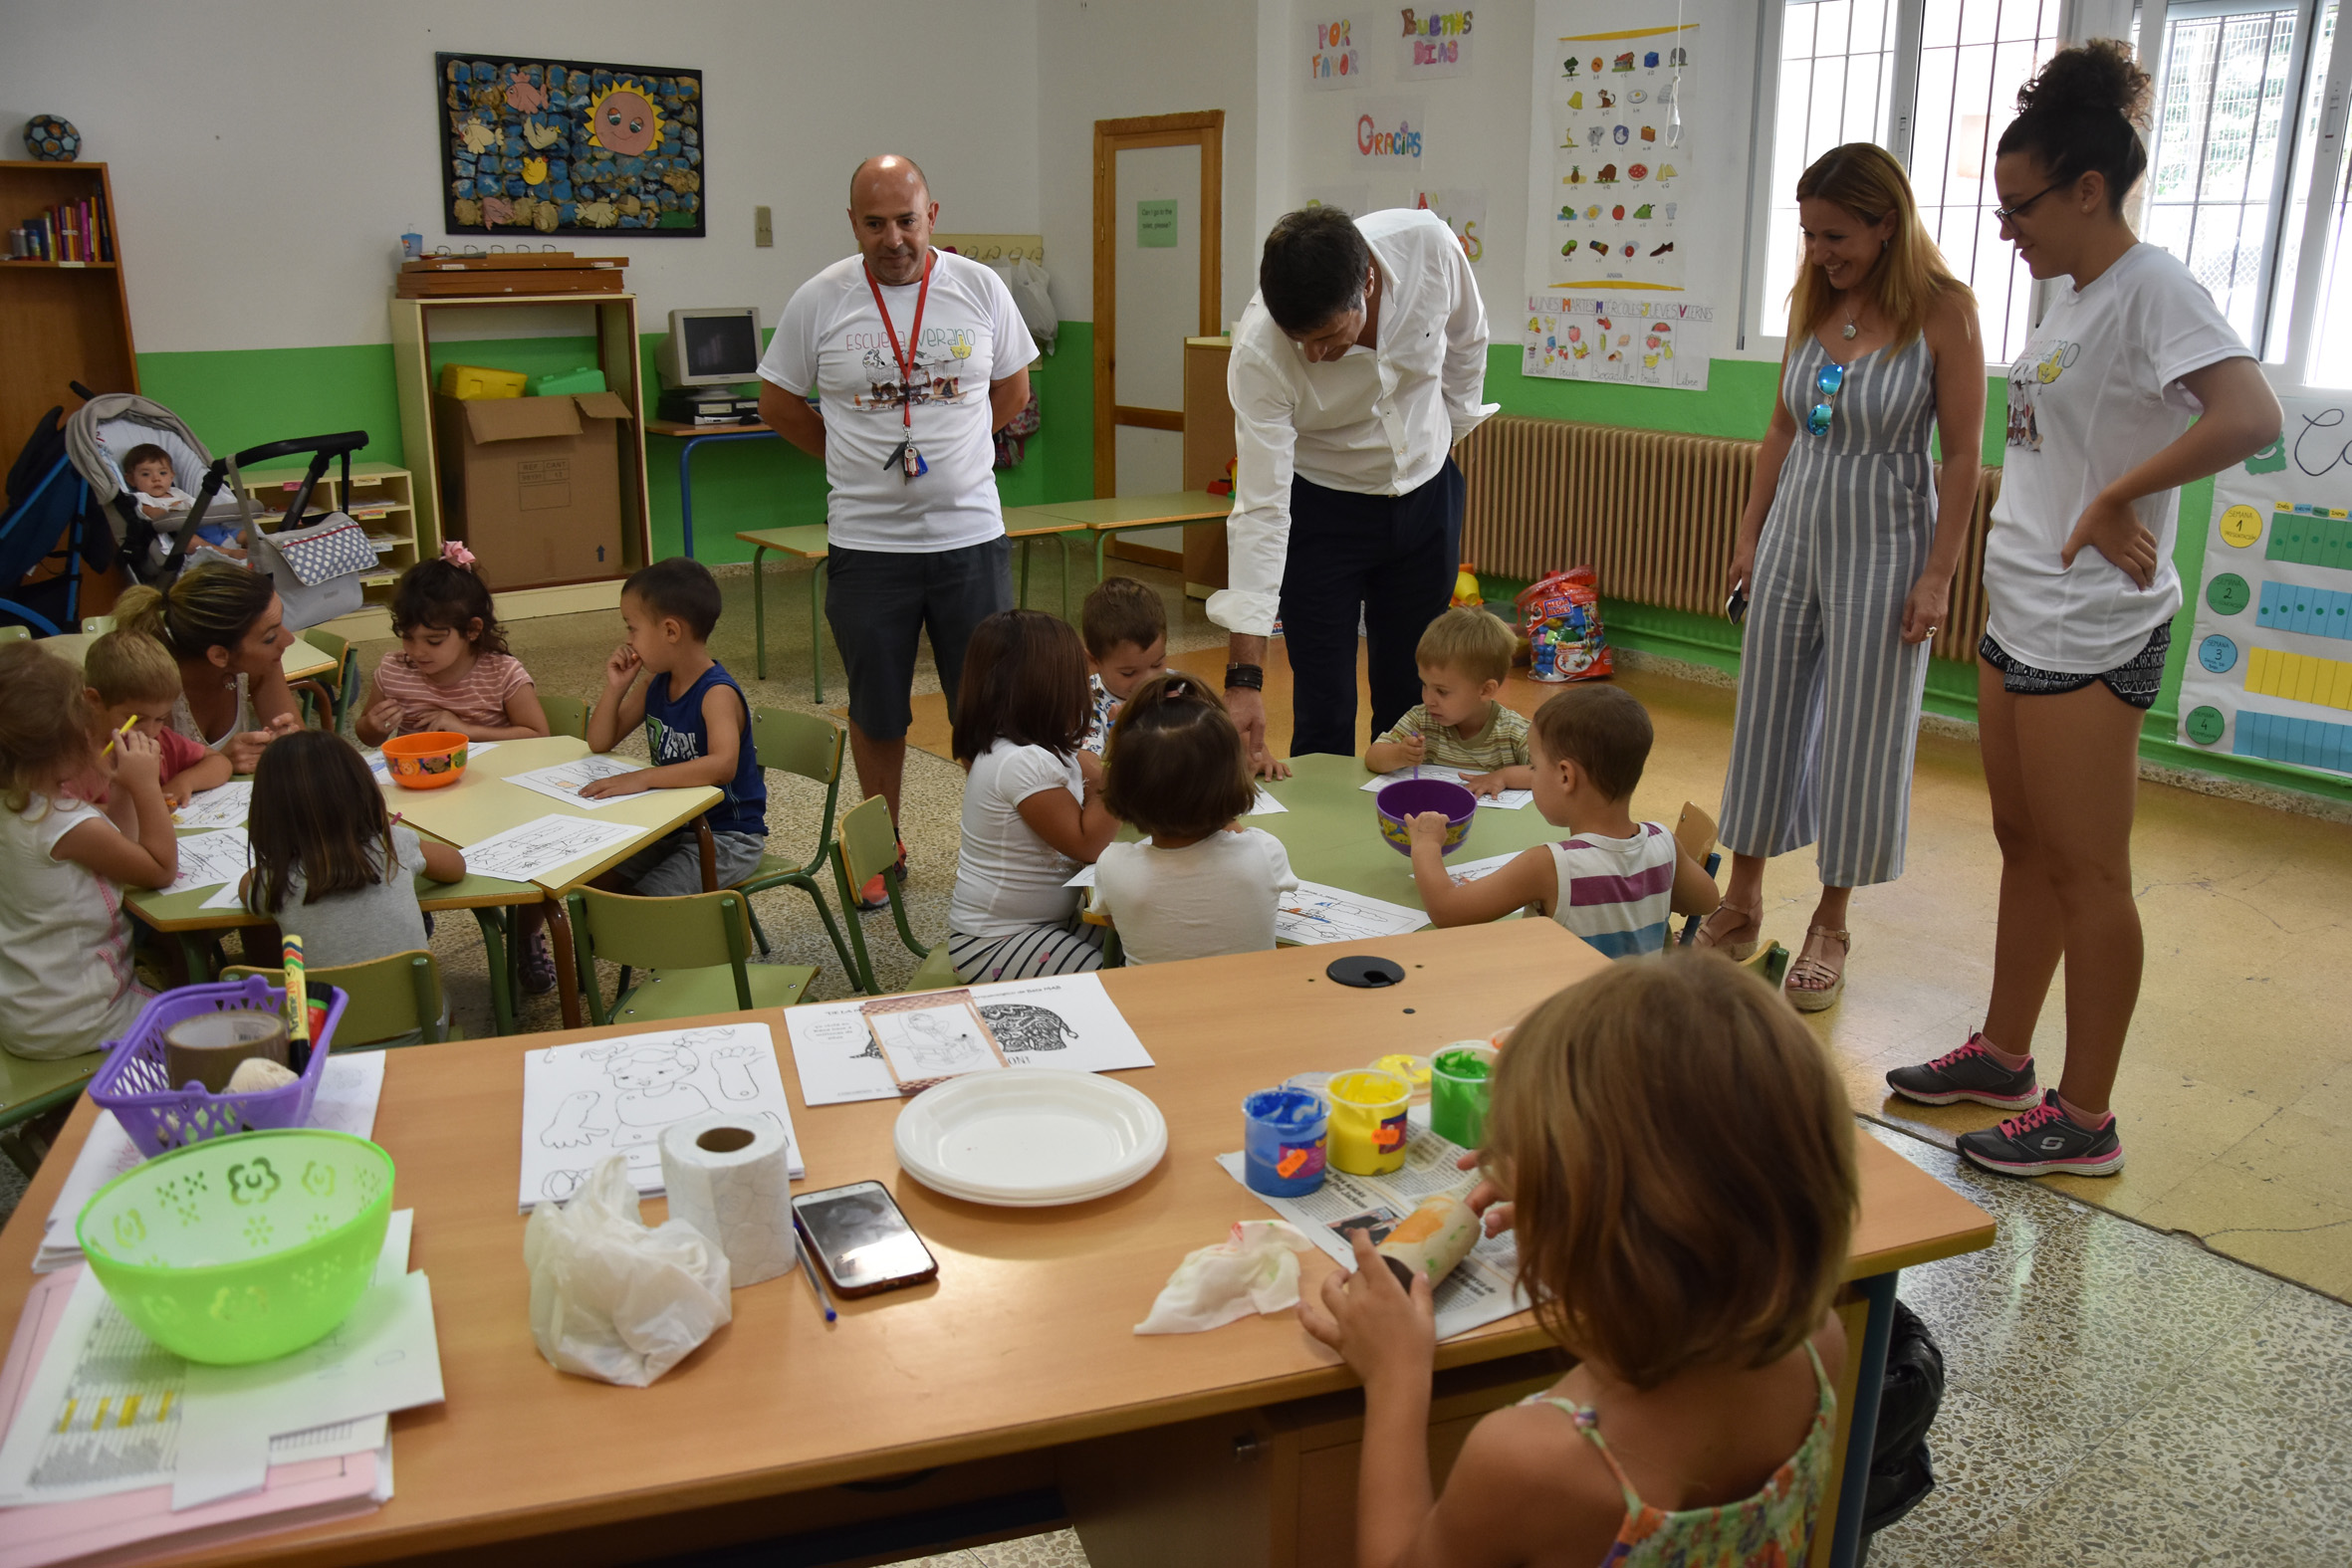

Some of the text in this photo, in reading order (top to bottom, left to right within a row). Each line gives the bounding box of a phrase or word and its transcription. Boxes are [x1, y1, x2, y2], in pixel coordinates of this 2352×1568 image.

[1317, 19, 1351, 50] POR
[1312, 49, 1359, 79] FAVOR
[1529, 297, 1559, 311] LUNES
[1562, 298, 1594, 312] MARTES
[1641, 302, 1678, 318] JUEVES
[1679, 304, 1714, 320] VIERNES
[1592, 363, 1635, 383] Bocadillo
[2228, 510, 2253, 520] SEMANA
[2235, 520, 2243, 532] 1
[2224, 587, 2233, 599] 2
[1546, 599, 1569, 608] MEGA
[1548, 606, 1570, 616] BLOKS
[2207, 639, 2231, 649] SEMANA
[2215, 649, 2223, 660] 3
[2201, 719, 2208, 731] 4
